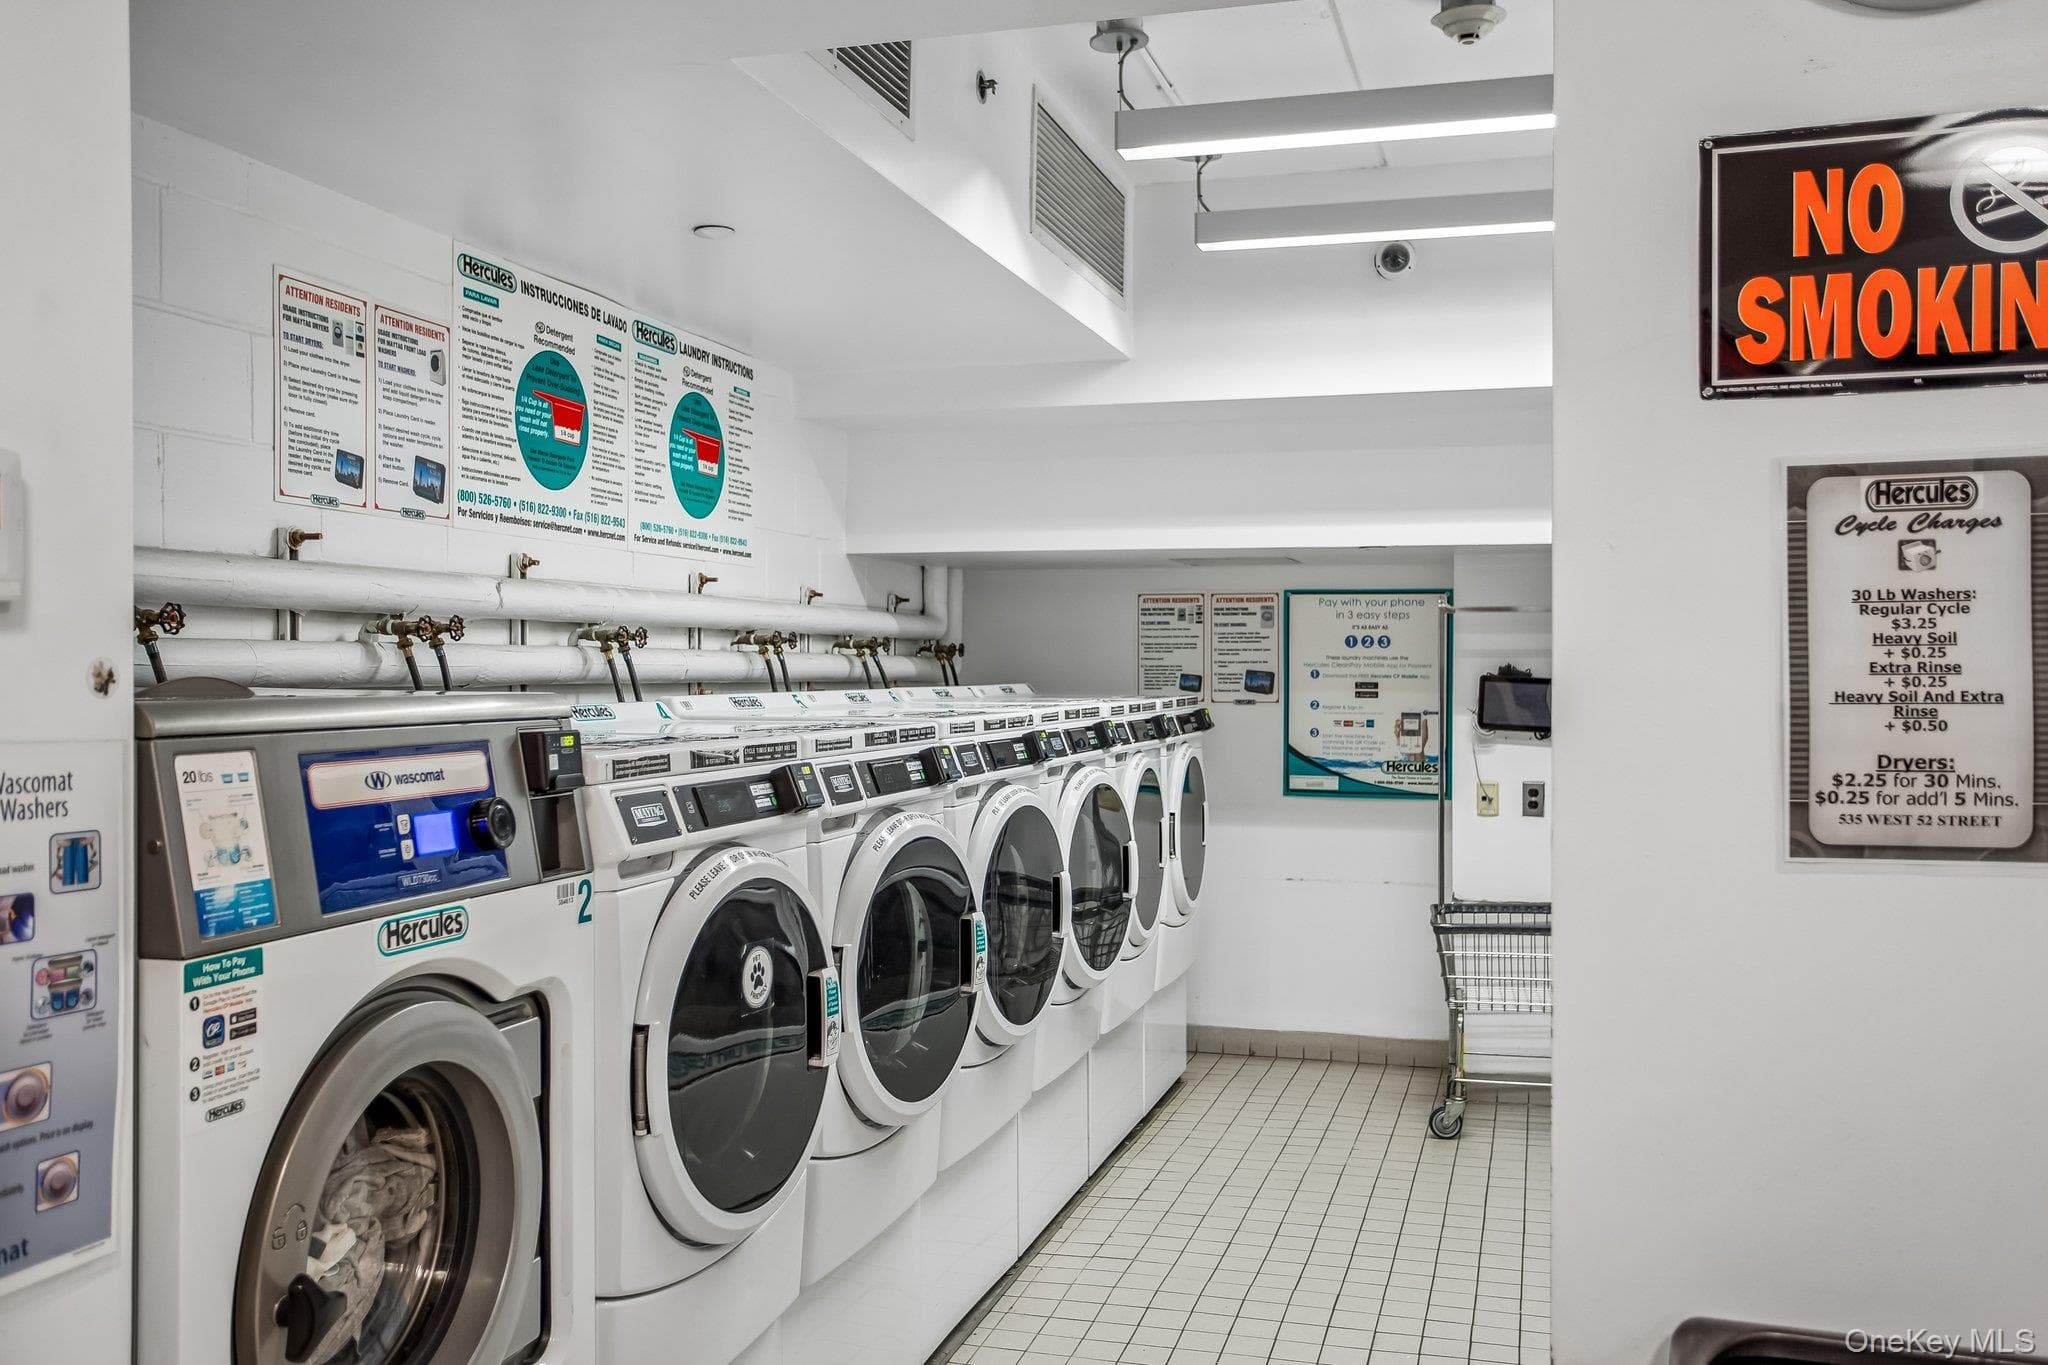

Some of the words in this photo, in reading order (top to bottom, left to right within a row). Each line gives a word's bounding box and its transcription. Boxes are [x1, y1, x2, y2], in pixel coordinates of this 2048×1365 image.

[1793, 163, 1904, 257] NO
[463, 255, 513, 289] Hercules
[285, 284, 323, 305] ATTENTION
[325, 296, 360, 317] RESIDENTS
[520, 280, 588, 317] INSTRUCCIONES
[591, 306, 600, 322] DE
[603, 311, 626, 333] LAVADO
[1735, 260, 2048, 366] SMOKIN
[380, 314, 413, 332] ATTENTION
[414, 324, 444, 341] RESIDENTS
[546, 324, 573, 344] Detergent
[636, 321, 674, 351] Hercules
[533, 334, 575, 355] Recommended
[679, 341, 710, 364] LAUNDRY
[712, 353, 753, 381] INSTRUCTIONS
[1876, 480, 1970, 505] Hercules
[457, 488, 476, 505] (800)
[478, 492, 511, 508] 526-5760
[519, 499, 535, 514] (516)
[573, 509, 582, 521] Fax
[584, 510, 599, 525] (516)
[457, 506, 466, 516] Por
[468, 508, 493, 521] Servicios
[495, 514, 498, 523] y
[1834, 515, 1896, 535] Cycle
[1907, 513, 2003, 534] Charges
[641, 534, 656, 544] Service
[1319, 598, 1337, 607] Pay
[1341, 598, 1361, 606] with
[1365, 599, 1387, 607] your
[1391, 598, 1425, 607] phone
[1852, 590, 1871, 600] 30
[1878, 589, 1895, 600] Lb
[1902, 589, 1976, 600] Washers:
[1336, 610, 1344, 619] in
[1348, 611, 1353, 619] 3
[1357, 612, 1380, 620] easy
[1384, 611, 1410, 620] steps
[1860, 605, 1921, 617] Regular
[1927, 604, 1970, 616] Cycle
[1892, 618, 1937, 630] $3.25
[1873, 634, 1921, 644] Heavy
[1928, 632, 1956, 644] Soil
[1901, 647, 1946, 659] $0.25
[1870, 663, 1911, 673] Extra
[1918, 662, 1961, 673] Rinse
[1902, 677, 1947, 688] $0.25
[730, 697, 762, 709] Hercules
[1835, 692, 1883, 703] Heavy
[1890, 692, 1918, 702] Soil
[1926, 692, 1955, 702] And
[1961, 692, 2003, 702] Extra
[572, 705, 612, 718] Hercules
[1894, 707, 1938, 717] Rinse
[1902, 720, 1948, 732] $0.50
[1386, 762, 1438, 772] Hercules
[1877, 755, 1954, 771] Dryers:
[183, 771, 197, 783] 20
[394, 768, 444, 785] wascomat
[1832, 773, 1886, 788] $2.25
[1894, 775, 1917, 787] for
[1924, 775, 1948, 787] 30
[1957, 775, 2000, 788] Mins.
[1815, 791, 1869, 806] $0.25
[1876, 791, 1900, 805] for
[1907, 791, 1947, 805] add'l
[1954, 792, 1965, 805] 5
[1974, 792, 2018, 807] Mins.
[0, 797, 68, 821] Washers
[1839, 815, 1862, 824] 535
[1867, 815, 1913, 825] WEST
[1917, 815, 1932, 825] 52
[1937, 816, 2002, 827] STREET
[689, 875, 711, 899] PLEASE
[578, 879, 592, 923] 2
[386, 913, 462, 948] Hercules
[202, 960, 221, 973] How
[222, 957, 231, 968] To
[232, 954, 246, 968] Pay
[192, 973, 211, 987] With
[212, 969, 231, 982] Your
[232, 963, 255, 978] Phone
[208, 1101, 243, 1120] Hercules
